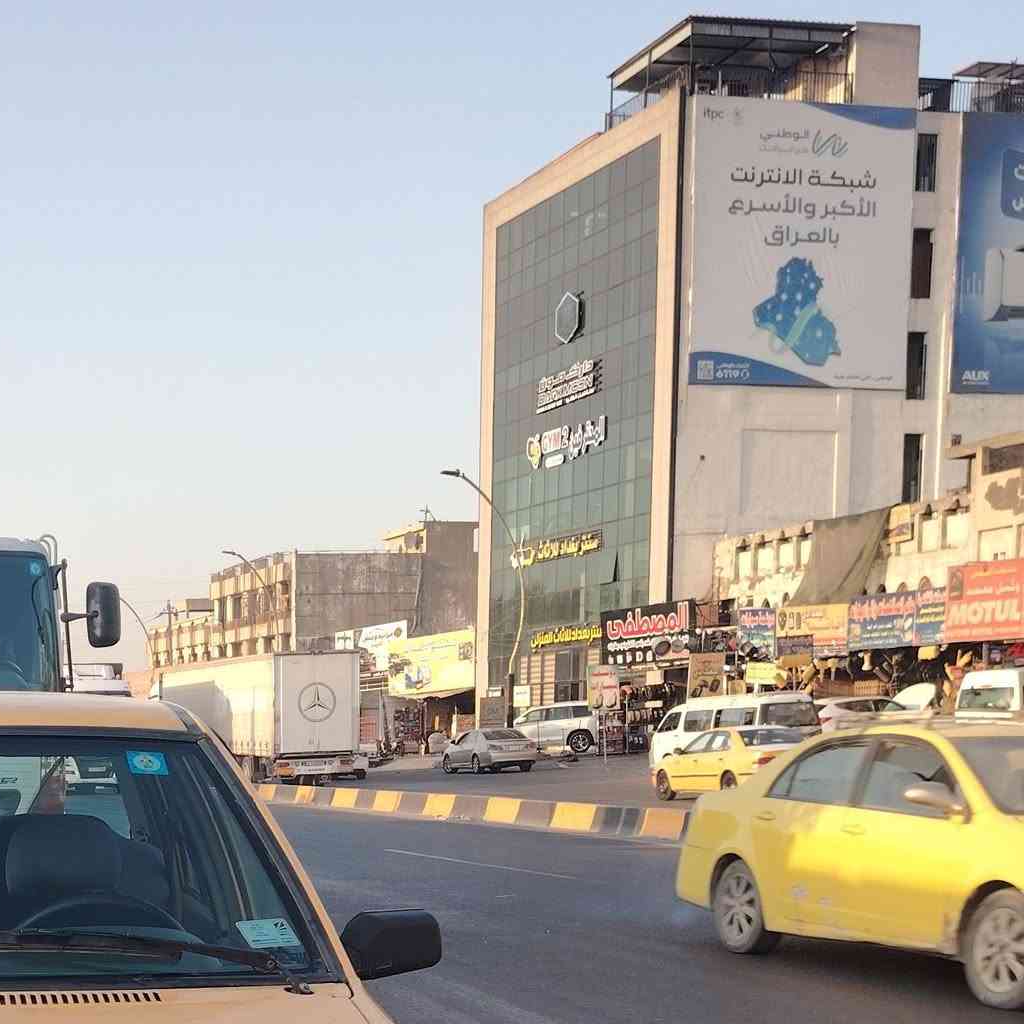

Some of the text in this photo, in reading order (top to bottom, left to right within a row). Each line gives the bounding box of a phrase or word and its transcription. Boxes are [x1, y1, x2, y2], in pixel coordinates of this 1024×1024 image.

[760, 128, 810, 141] الوطني
[730, 166, 876, 193] شبكة الانترنت
[728, 193, 877, 221] الأكبر والأسرع
[764, 225, 840, 248] بالعراق
[607, 601, 688, 639] المصطفى
[948, 598, 1021, 625] MOTUL
